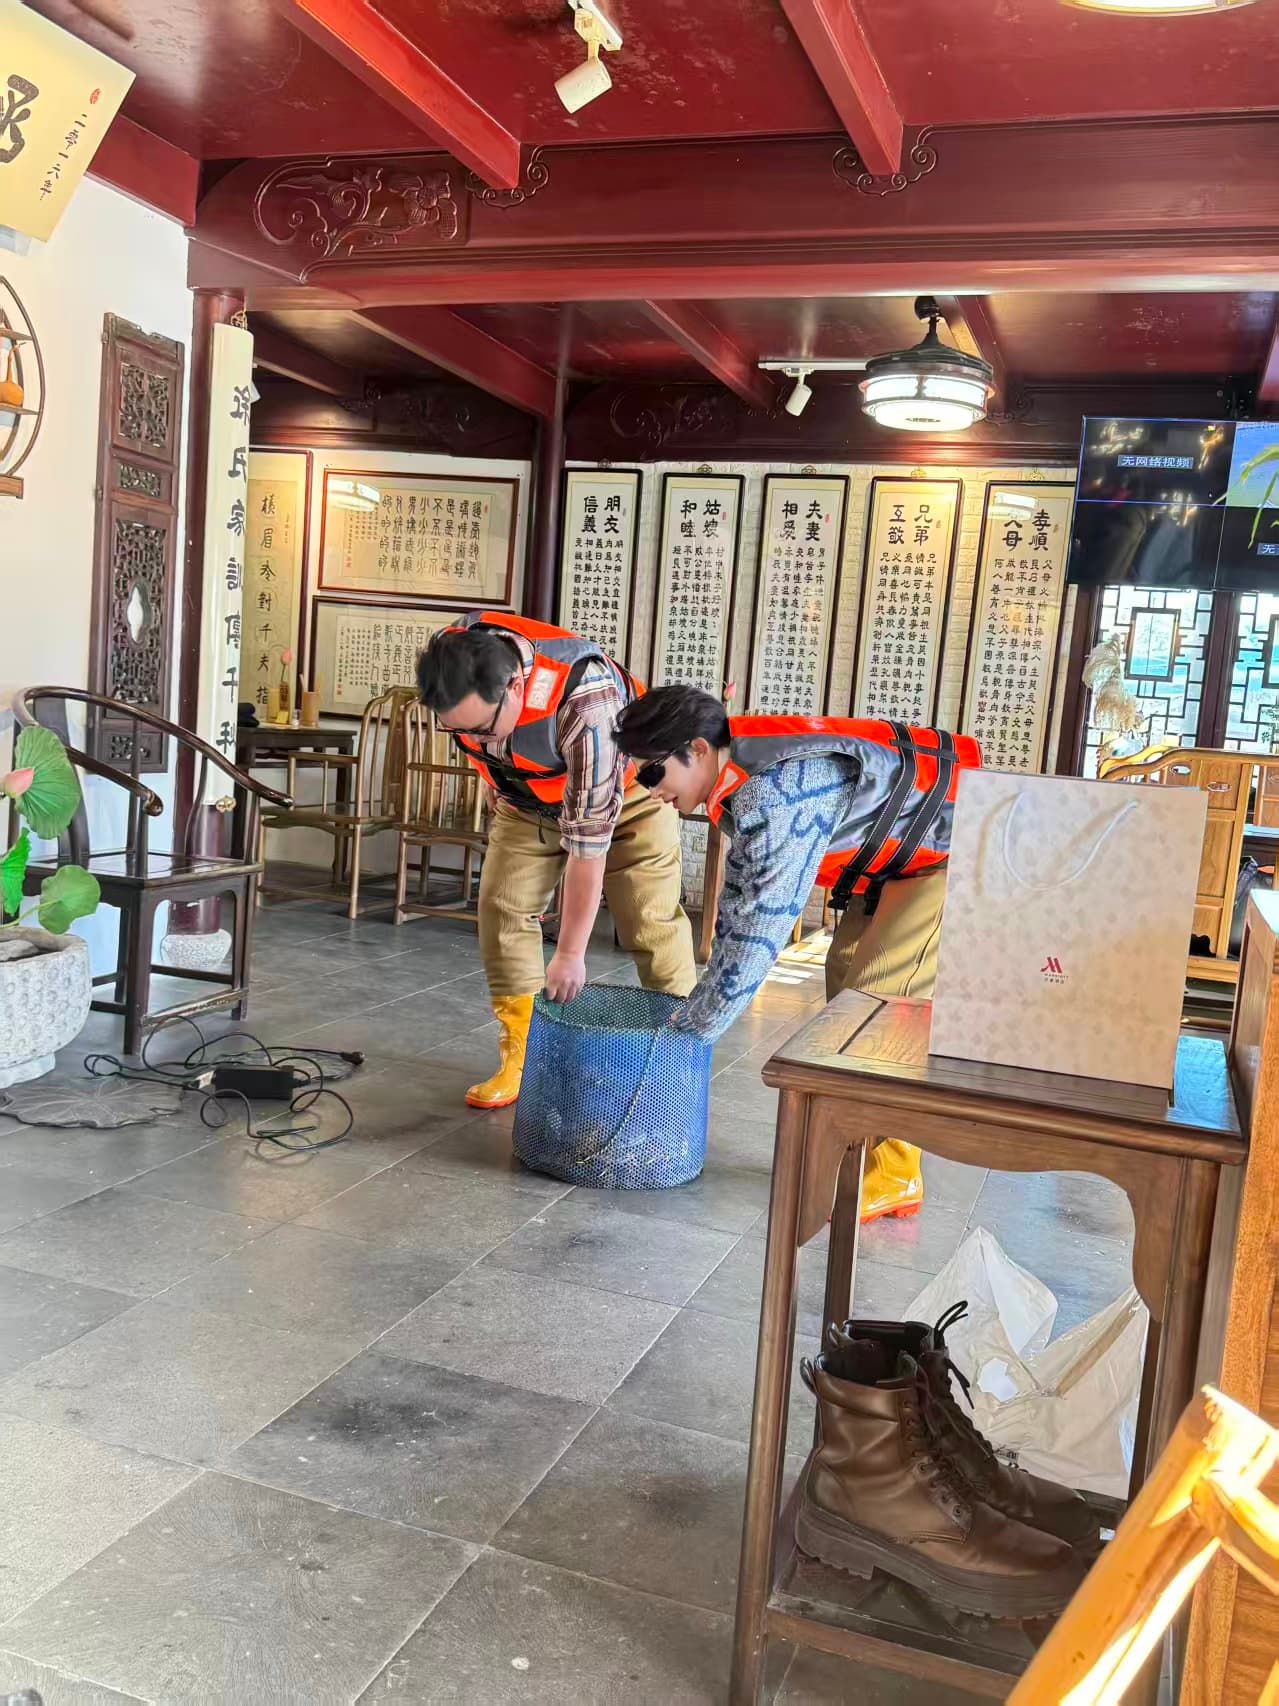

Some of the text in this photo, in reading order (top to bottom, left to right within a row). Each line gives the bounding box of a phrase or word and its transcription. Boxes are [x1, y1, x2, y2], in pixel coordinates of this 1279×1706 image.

[1121, 456, 1192, 468] 无网络视频
